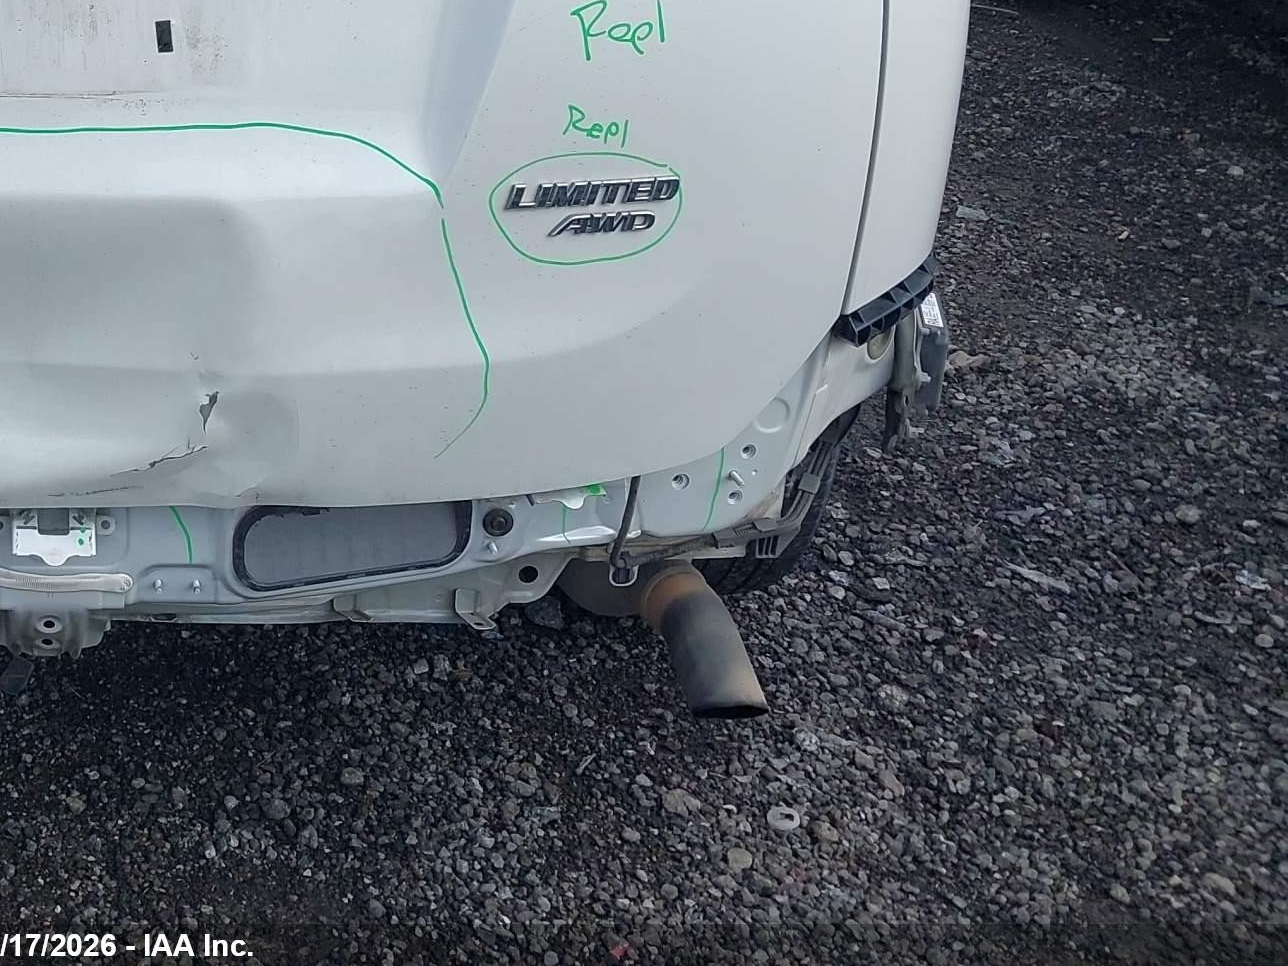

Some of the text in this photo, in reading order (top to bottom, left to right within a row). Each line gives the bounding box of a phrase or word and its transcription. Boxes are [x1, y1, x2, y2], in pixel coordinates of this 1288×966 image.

[562, 104, 629, 148] Repl
[504, 174, 680, 211] LIMITED
[547, 210, 656, 238] AWD
